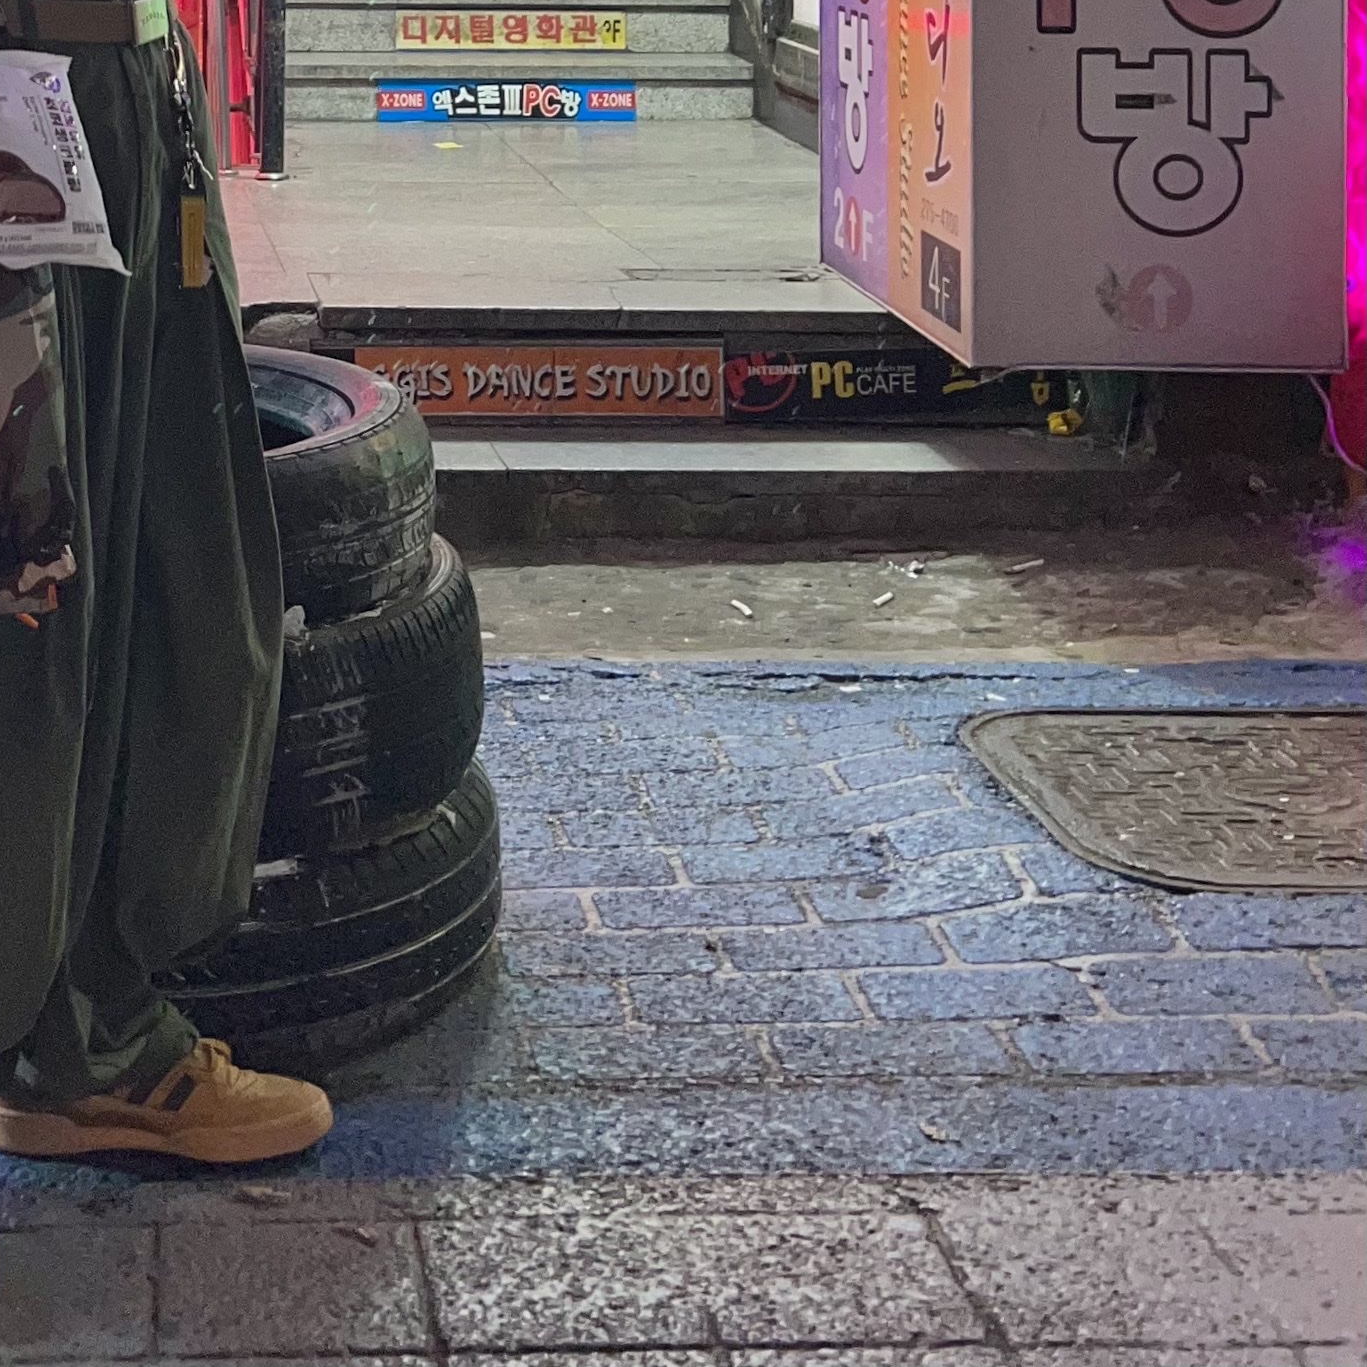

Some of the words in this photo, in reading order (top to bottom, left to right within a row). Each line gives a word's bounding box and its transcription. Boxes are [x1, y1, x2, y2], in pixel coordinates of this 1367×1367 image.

[401, 13, 599, 45] 디지털영화관
[381, 92, 425, 109] X-ZONE
[590, 91, 633, 109] X-ZONE
[462, 361, 576, 399] DANCE
[585, 362, 712, 399] STUDIO
[747, 363, 808, 377] INTERNET
[810, 359, 856, 399] PC
[856, 373, 918, 396] CAFE
